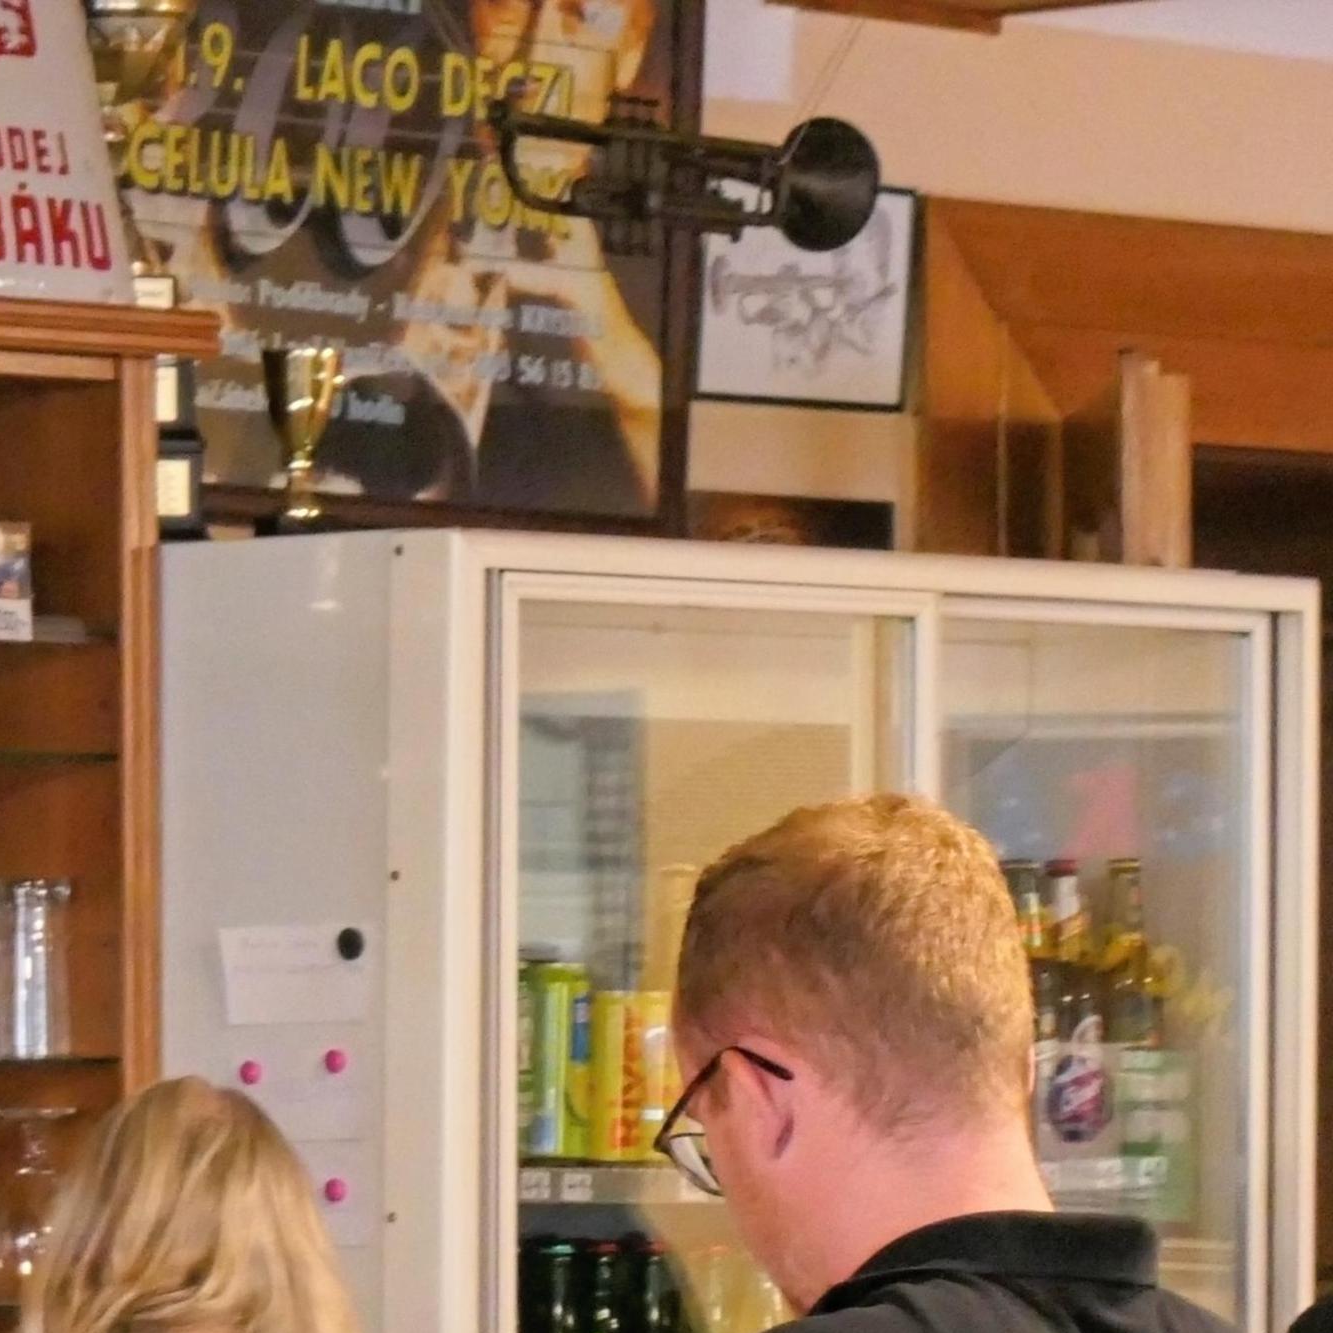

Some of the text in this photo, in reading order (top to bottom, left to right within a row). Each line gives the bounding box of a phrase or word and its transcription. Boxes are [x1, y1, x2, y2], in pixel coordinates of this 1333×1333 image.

[294, 34, 421, 115] LACO
[127, 119, 295, 206] CELULA
[313, 142, 423, 218] NEW
